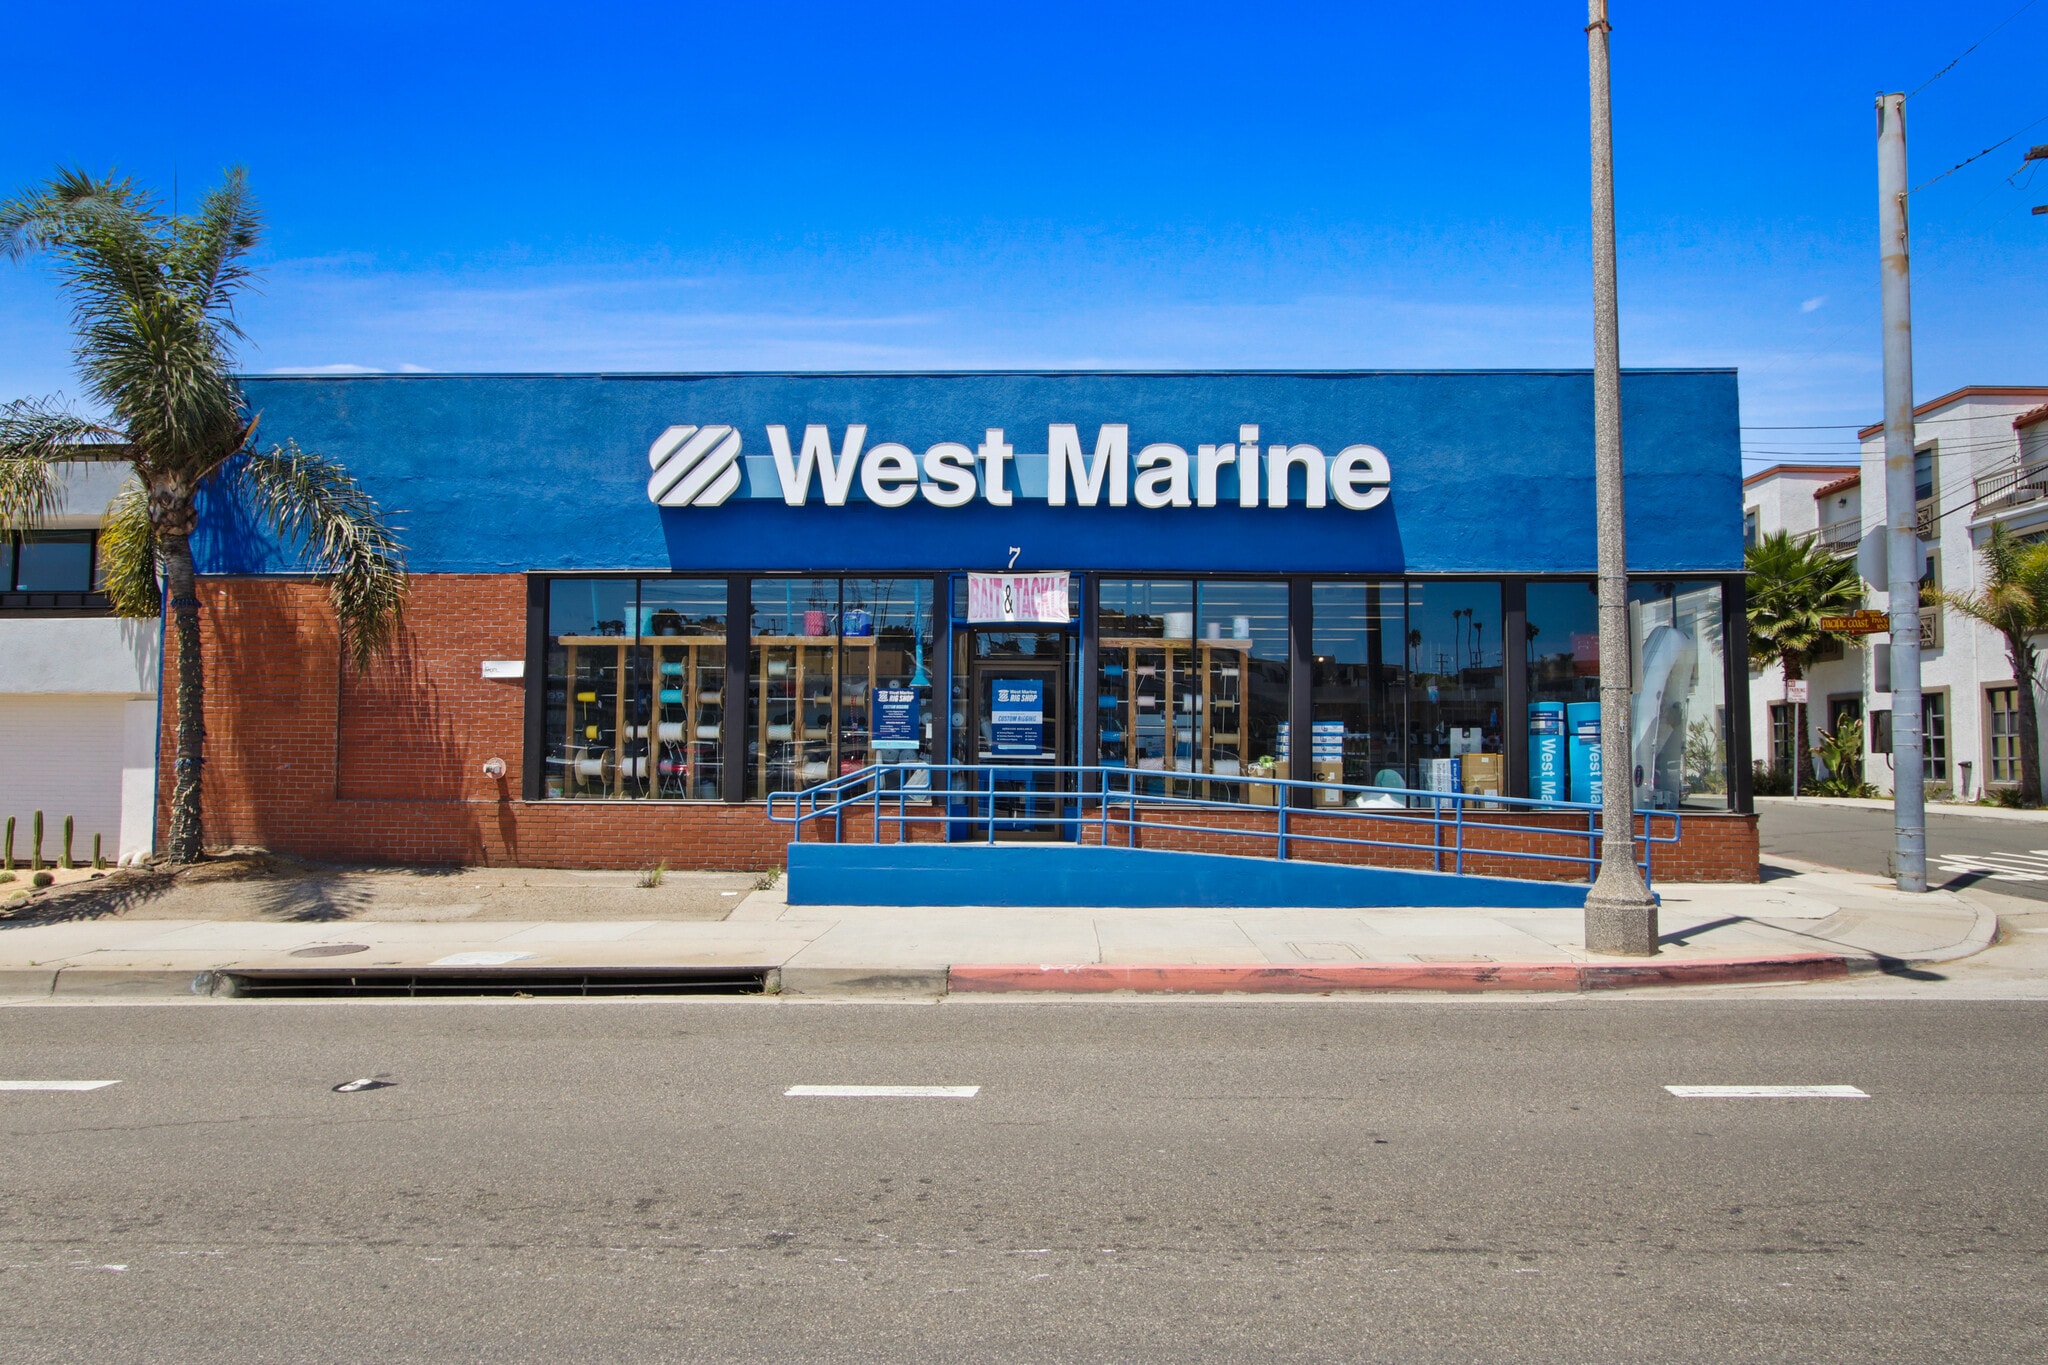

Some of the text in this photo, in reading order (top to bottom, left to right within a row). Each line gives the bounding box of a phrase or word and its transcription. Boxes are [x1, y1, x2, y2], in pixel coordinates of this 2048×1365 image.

[766, 424, 1391, 510] West Marine
[1008, 546, 1021, 569] 7
[970, 577, 1067, 619] BAIT & TACKLE
[1541, 738, 1556, 777] West
